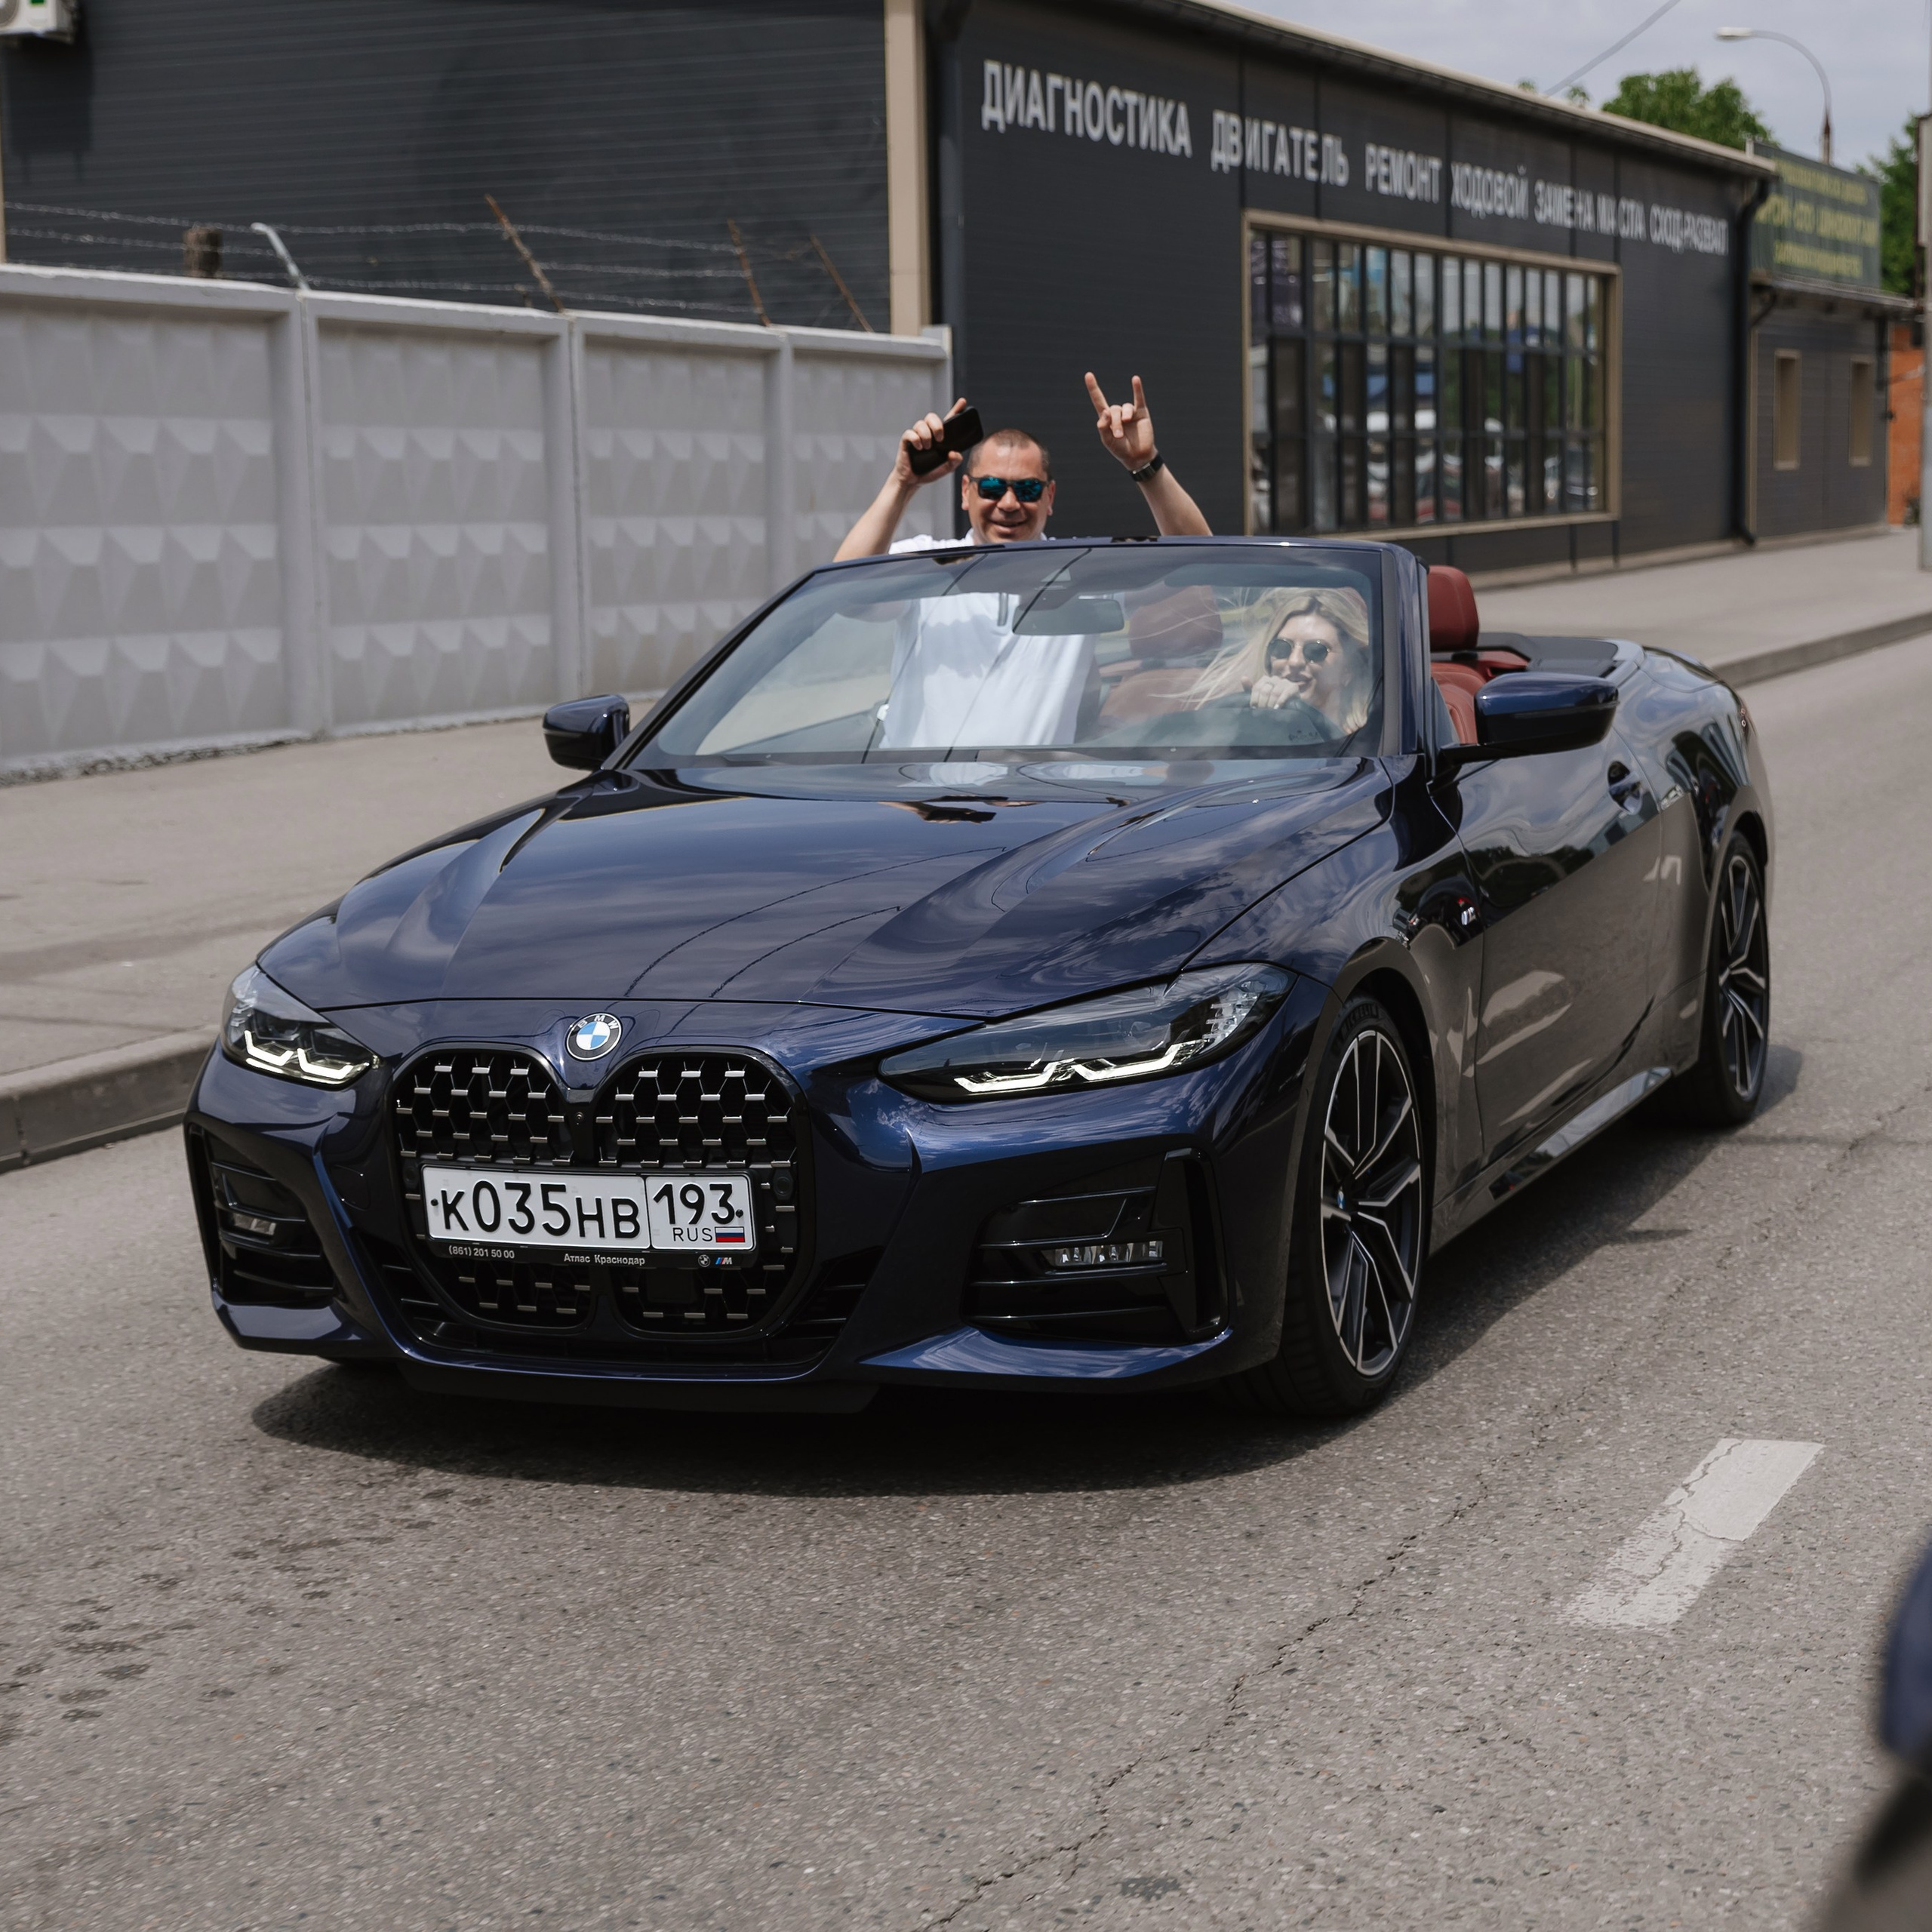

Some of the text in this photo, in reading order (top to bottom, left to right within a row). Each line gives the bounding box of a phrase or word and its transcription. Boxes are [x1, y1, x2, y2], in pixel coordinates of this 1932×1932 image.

[982, 60, 1192, 158] ДИАГНОСТИКА
[1211, 109, 1349, 187] ДВИГАТЕЛЬ
[1365, 143, 1441, 203] РЕМОНТ
[1451, 164, 1529, 220] ХОДОВОЙ
[577, 1014, 619, 1029] BMW
[652, 1183, 735, 1225] 193
[672, 1227, 713, 1242] RUS
[448, 1245, 515, 1259] (861) 201 50 00
[564, 1253, 645, 1266] Атлас Краснодар
